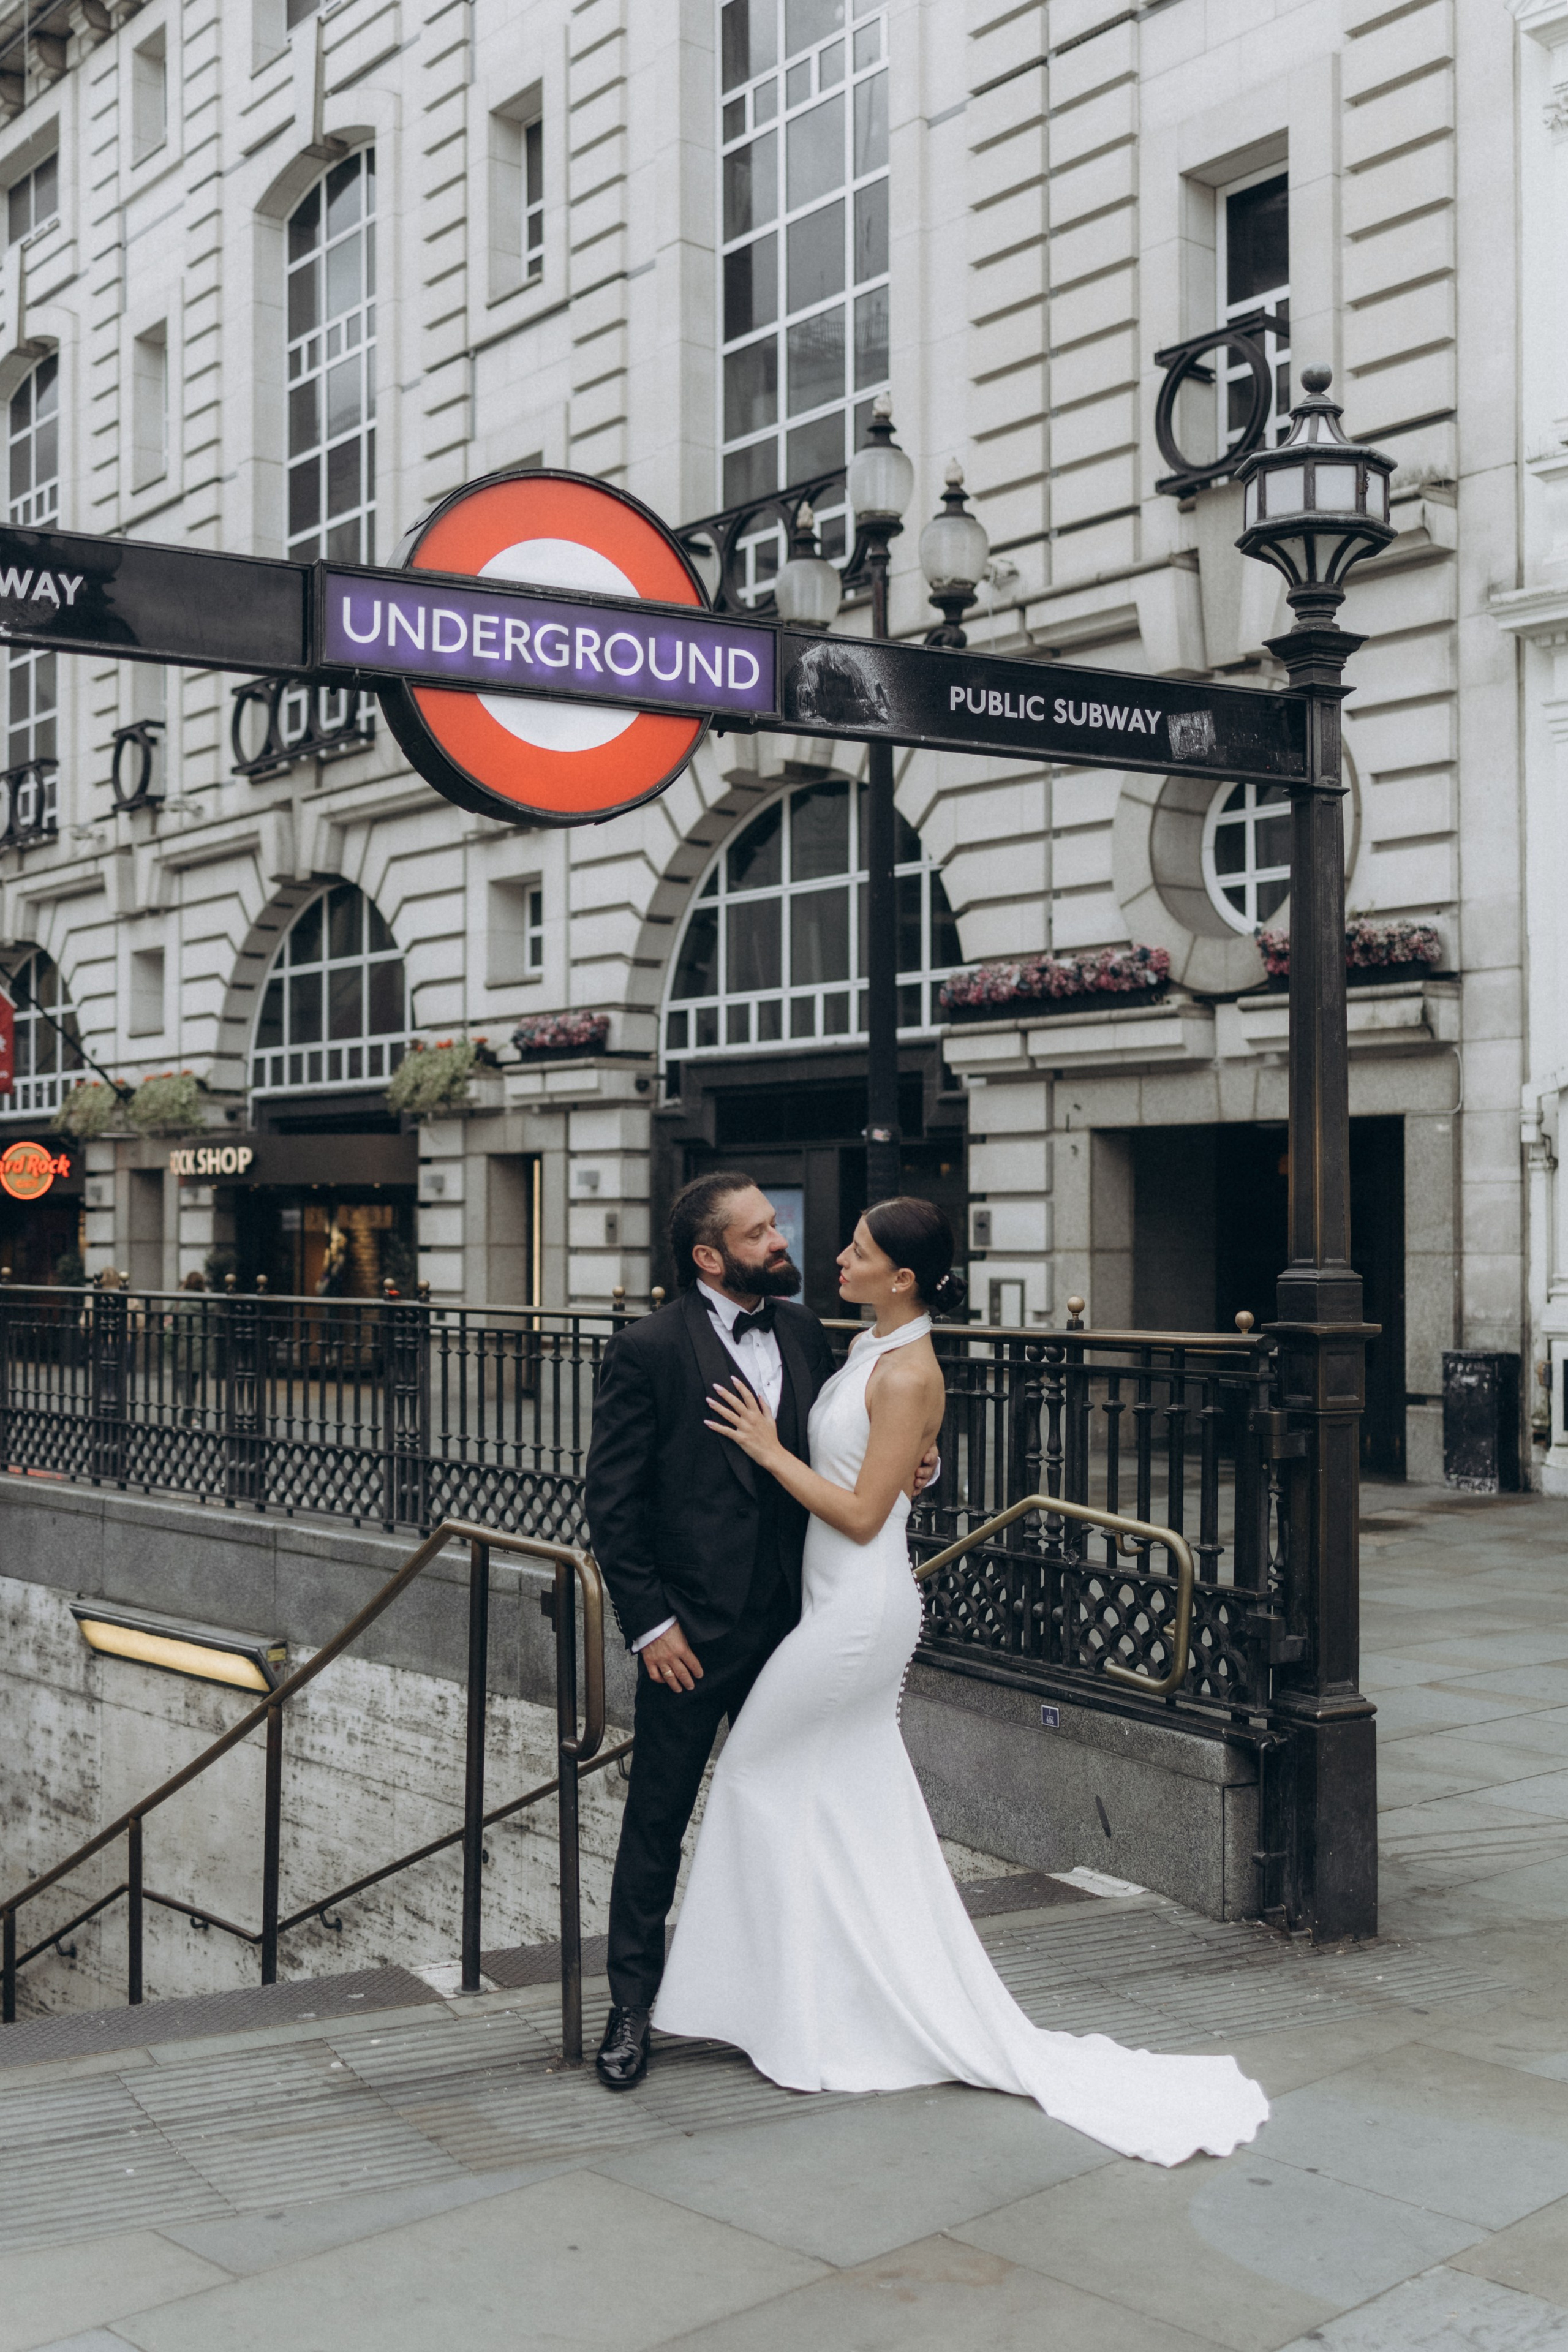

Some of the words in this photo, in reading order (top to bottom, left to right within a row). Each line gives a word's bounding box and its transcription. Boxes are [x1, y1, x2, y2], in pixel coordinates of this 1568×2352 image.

[342, 596, 760, 690] UNDERGROUND
[950, 685, 1044, 722] PUBLIC
[1053, 698, 1162, 734] SUBWAY
[26, 1153, 72, 1178] Rock
[197, 1146, 253, 1175] SHOP
